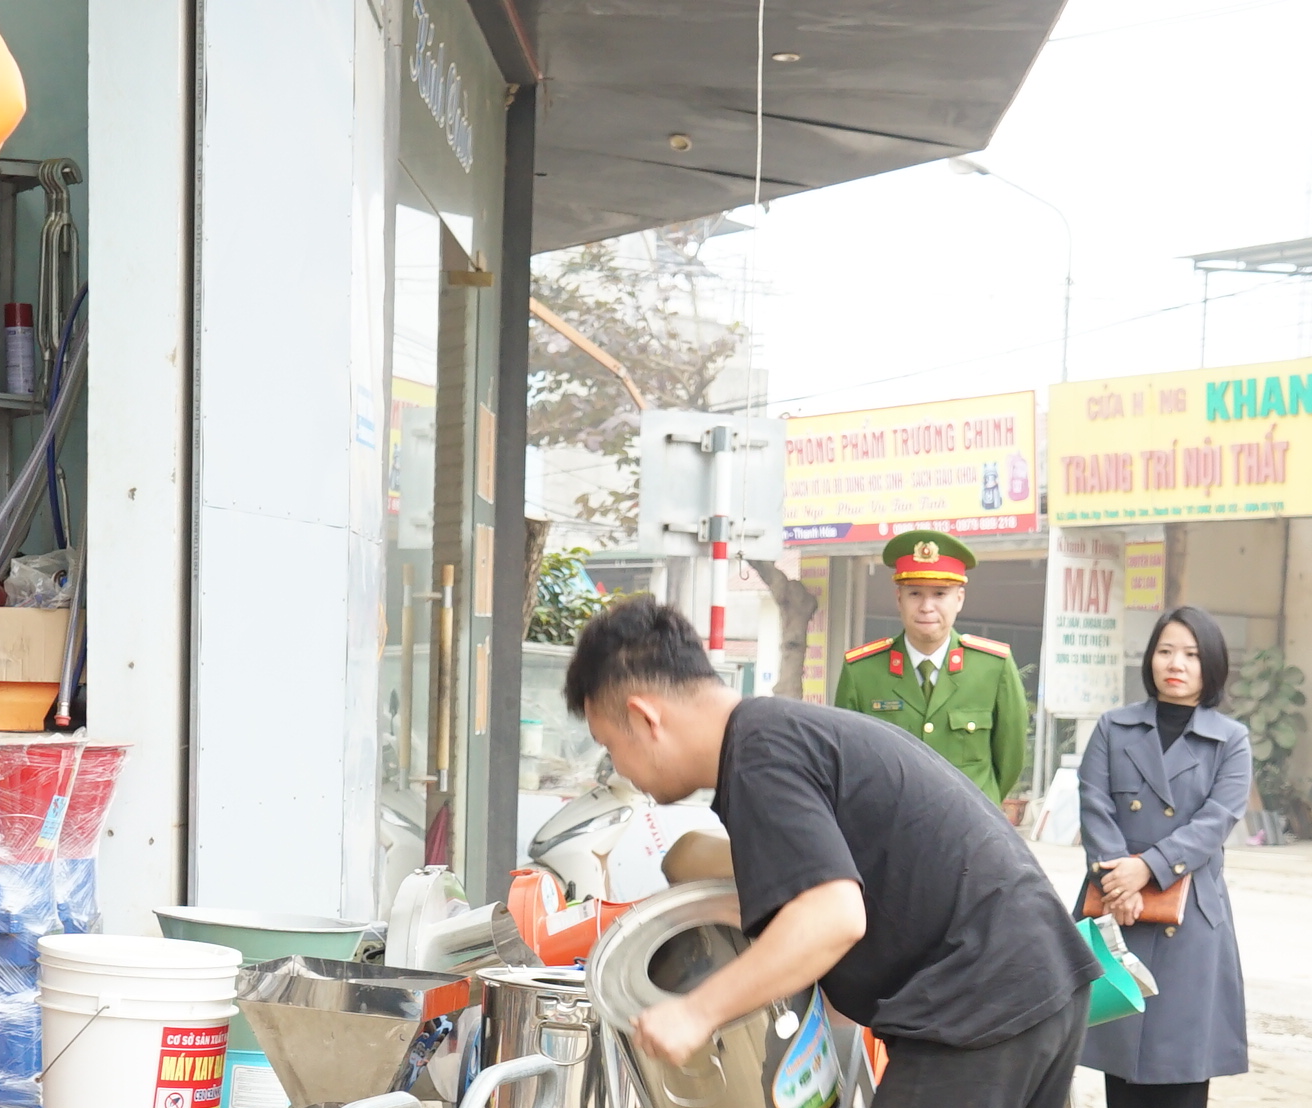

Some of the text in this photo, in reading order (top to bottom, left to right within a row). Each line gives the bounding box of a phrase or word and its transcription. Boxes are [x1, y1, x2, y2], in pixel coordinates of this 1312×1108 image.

[1133, 383, 1187, 416] HNG
[963, 416, 1016, 451] CHINH
[1062, 423, 1290, 498] TRANG TRÍ NỘI THẤT
[1063, 561, 1114, 614] MÁY
[167, 1034, 181, 1045] CƠ
[182, 1032, 194, 1045] SỞ
[195, 1033, 210, 1045] SẢN
[161, 1053, 193, 1081] MÁY
[193, 1056, 215, 1081] XAY
